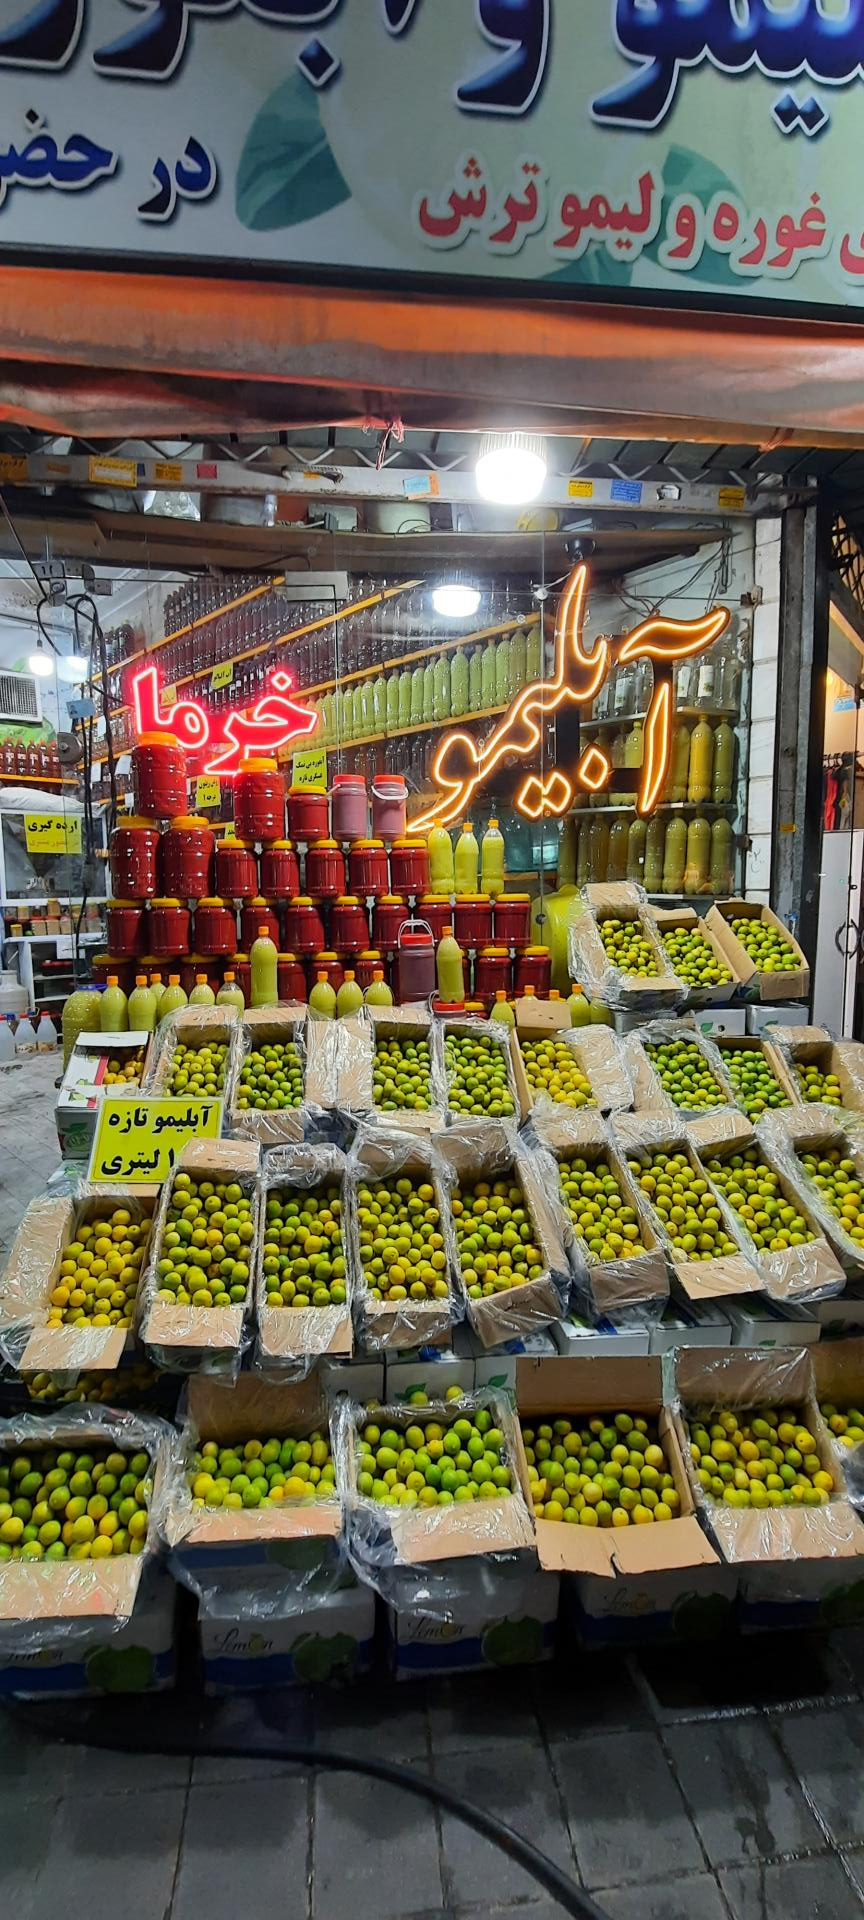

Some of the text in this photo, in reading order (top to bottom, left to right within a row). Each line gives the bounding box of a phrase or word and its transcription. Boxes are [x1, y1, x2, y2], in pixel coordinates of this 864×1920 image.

[137, 135, 217, 222] در
[418, 156, 541, 245] ترش
[553, 170, 656, 251] لیمو
[667, 203, 698, 260] و
[711, 191, 827, 268] غوره
[132, 664, 319, 776] خرما
[402, 560, 731, 834] آبلیمو
[28, 820, 78, 833] ارده گیری
[108, 1104, 214, 1134] آبلیمو تازه
[101, 1148, 160, 1176] لیتری
